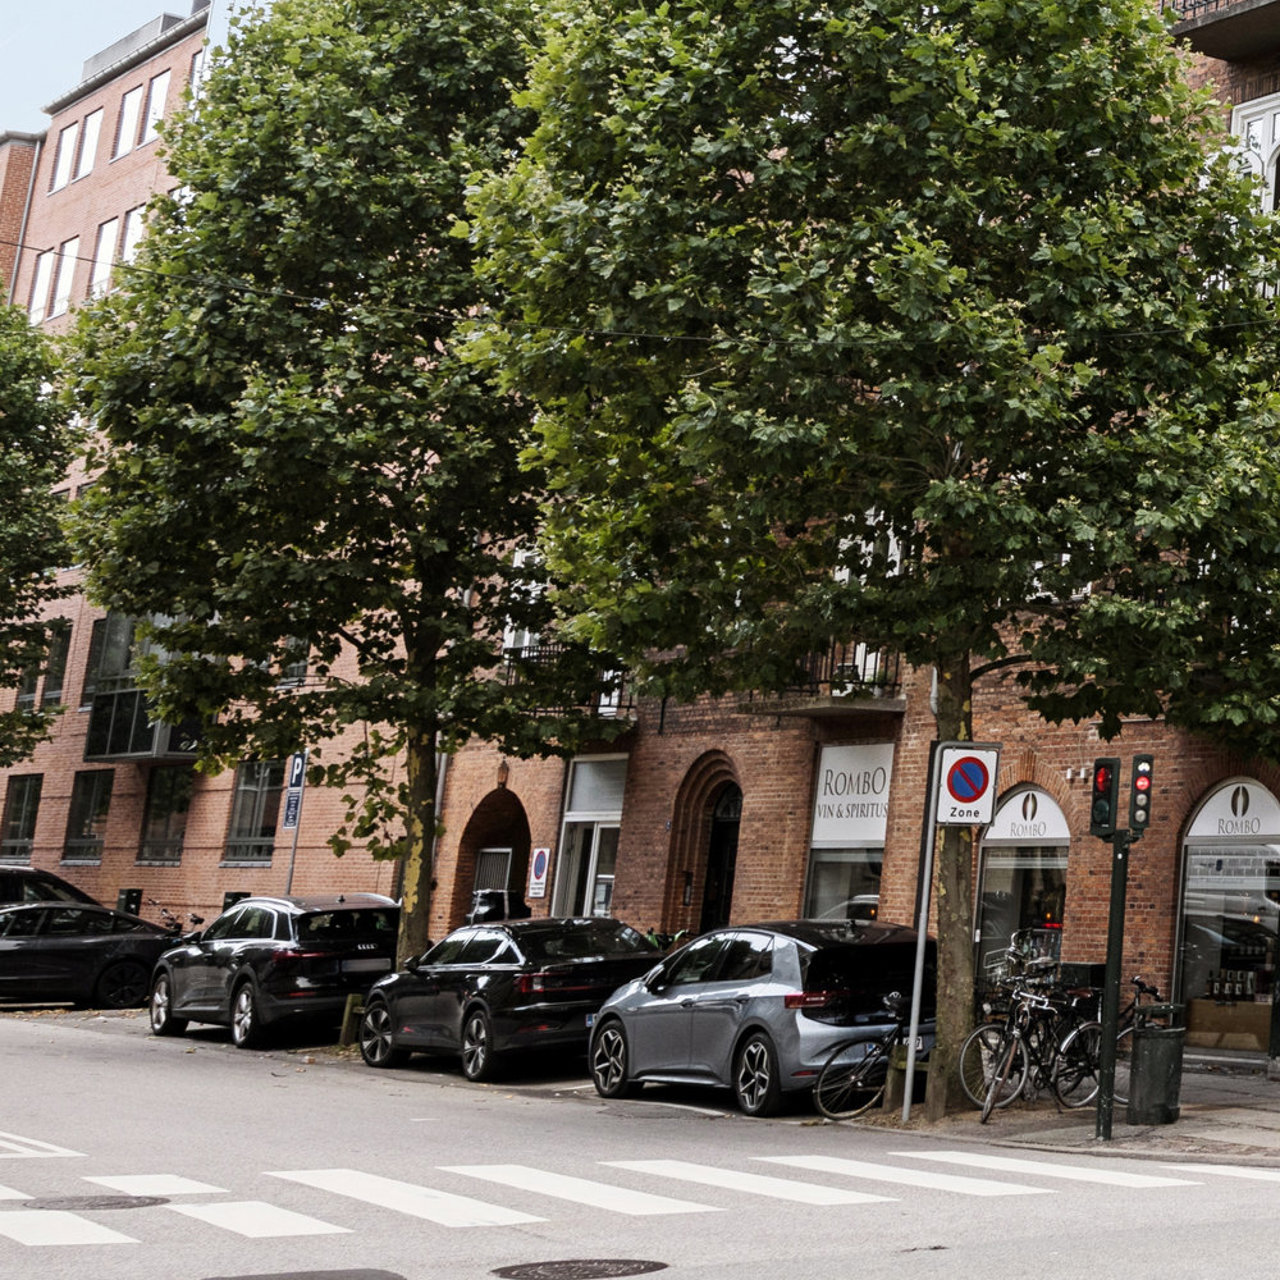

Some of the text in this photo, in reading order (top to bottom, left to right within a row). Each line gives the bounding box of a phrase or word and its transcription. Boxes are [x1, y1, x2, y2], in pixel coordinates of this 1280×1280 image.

[292, 757, 302, 783] P
[824, 766, 887, 796] ROMBO
[817, 802, 889, 819] VIN & SPIRITUS
[950, 807, 980, 818] Zone
[1010, 821, 1047, 837] ROMBO
[1217, 817, 1261, 834] ROMBO
